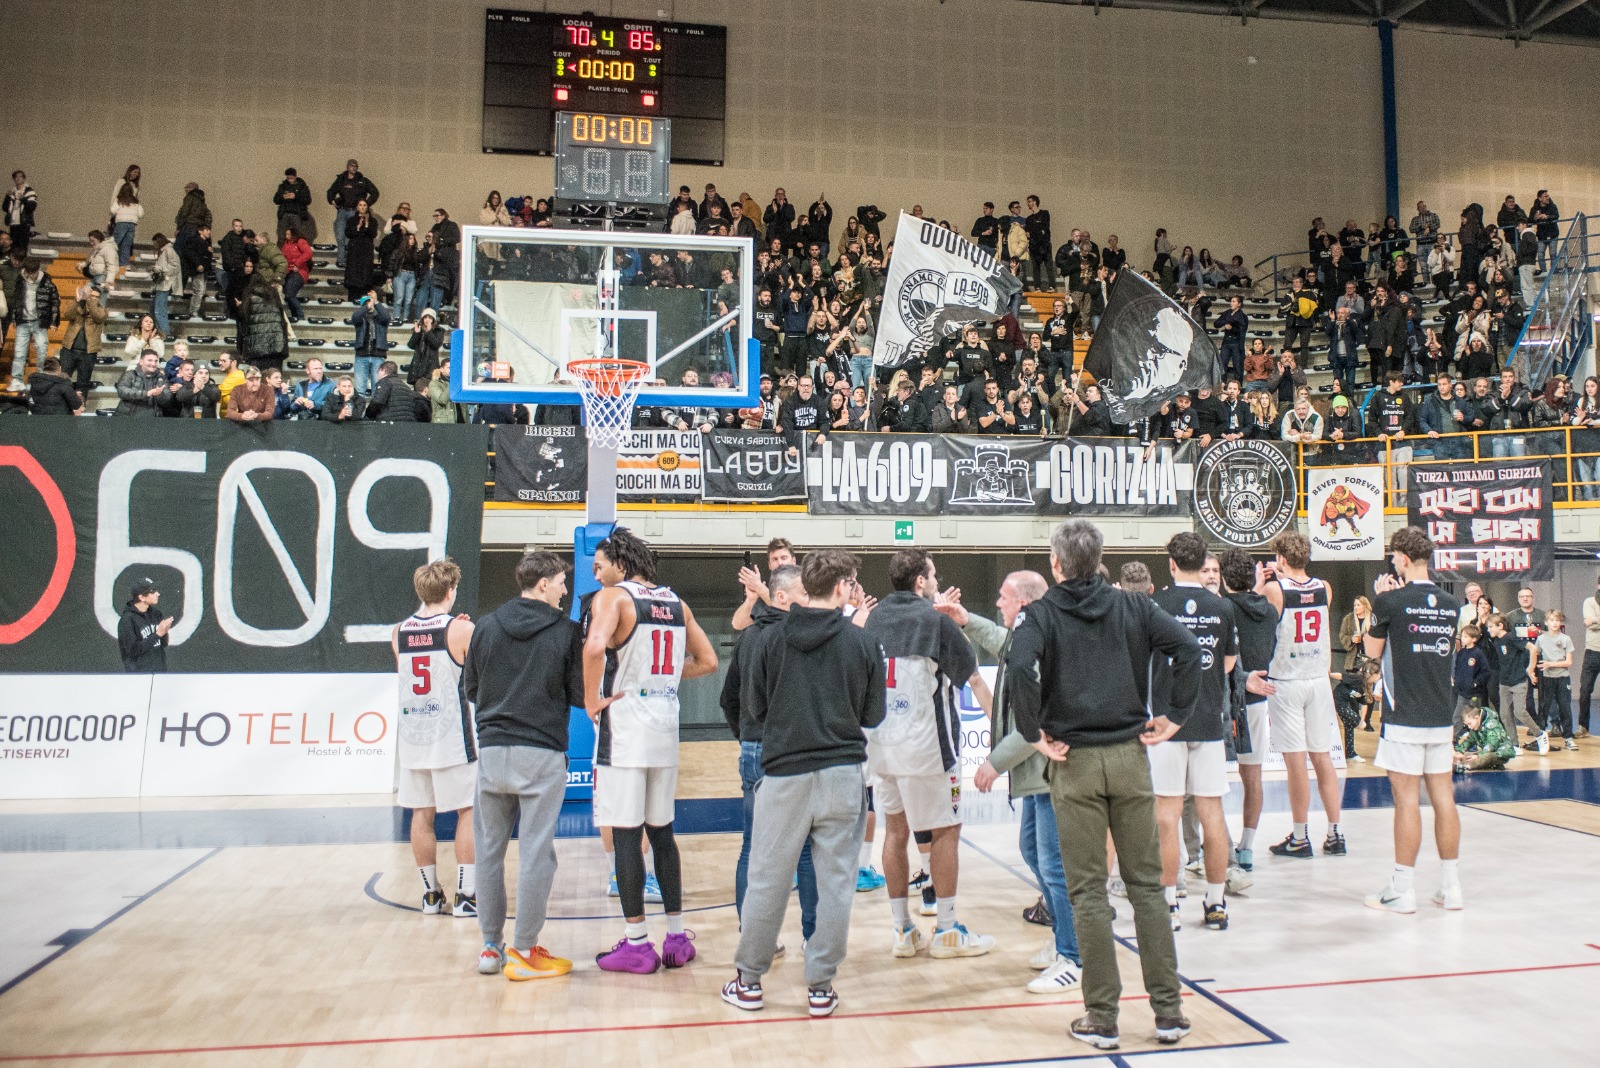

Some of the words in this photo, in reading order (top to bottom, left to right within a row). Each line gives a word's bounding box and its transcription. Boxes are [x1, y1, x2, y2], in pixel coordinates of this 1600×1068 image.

[563, 19, 593, 28] LOCALI
[624, 24, 653, 32] OSPITI
[566, 27, 590, 46] 70
[602, 30, 614, 48] 4
[630, 31, 654, 50] 85
[579, 59, 634, 81] 00:00
[572, 114, 652, 145] 00:00
[901, 273, 933, 301] DINAMO
[656, 433, 677, 448] MA
[680, 433, 700, 448] CIO
[746, 436, 788, 446] SABOTIN
[1204, 440, 1244, 468] DINAMO
[1248, 440, 1288, 472] GORIZIA
[822, 441, 860, 502] LA
[866, 441, 934, 503] 609
[1050, 444, 1178, 506] GORIZIA
[1416, 472, 1449, 483] FORZA
[1452, 469, 1495, 482] DINAMO
[1498, 466, 1542, 480] GORIZIA
[616, 474, 656, 490] CIOCHI
[660, 474, 680, 490] MA
[684, 474, 702, 490] BU
[737, 482, 773, 491] GORIZIA
[1312, 478, 1337, 496] BEVER
[1344, 476, 1380, 496] FOREVER
[518, 489, 580, 502] SPAGNOI
[1418, 486, 1480, 518] QUEI
[1483, 486, 1542, 515] CON
[1198, 500, 1224, 532] BAGAJ
[1224, 530, 1260, 543] PORTA
[1261, 500, 1293, 538] ROMANA
[1427, 521, 1457, 544] LA
[94, 449, 452, 648] 609
[1312, 536, 1342, 551] DINAMO
[1346, 536, 1375, 551] GORIZIA
[1434, 548, 1459, 572] IN
[1476, 546, 1531, 574] MAN
[1406, 607, 1438, 616] Goriziana
[1294, 610, 1322, 644] 13
[1418, 624, 1455, 637] comody
[1197, 634, 1219, 648] ody
[651, 629, 674, 675] 11
[412, 655, 432, 696] 5
[427, 704, 440, 712] 360
[895, 700, 909, 708] 360
[159, 710, 388, 748] HOTELLO
[307, 746, 341, 756] Hostel
[344, 746, 352, 756] &
[356, 748, 386, 756] more.
